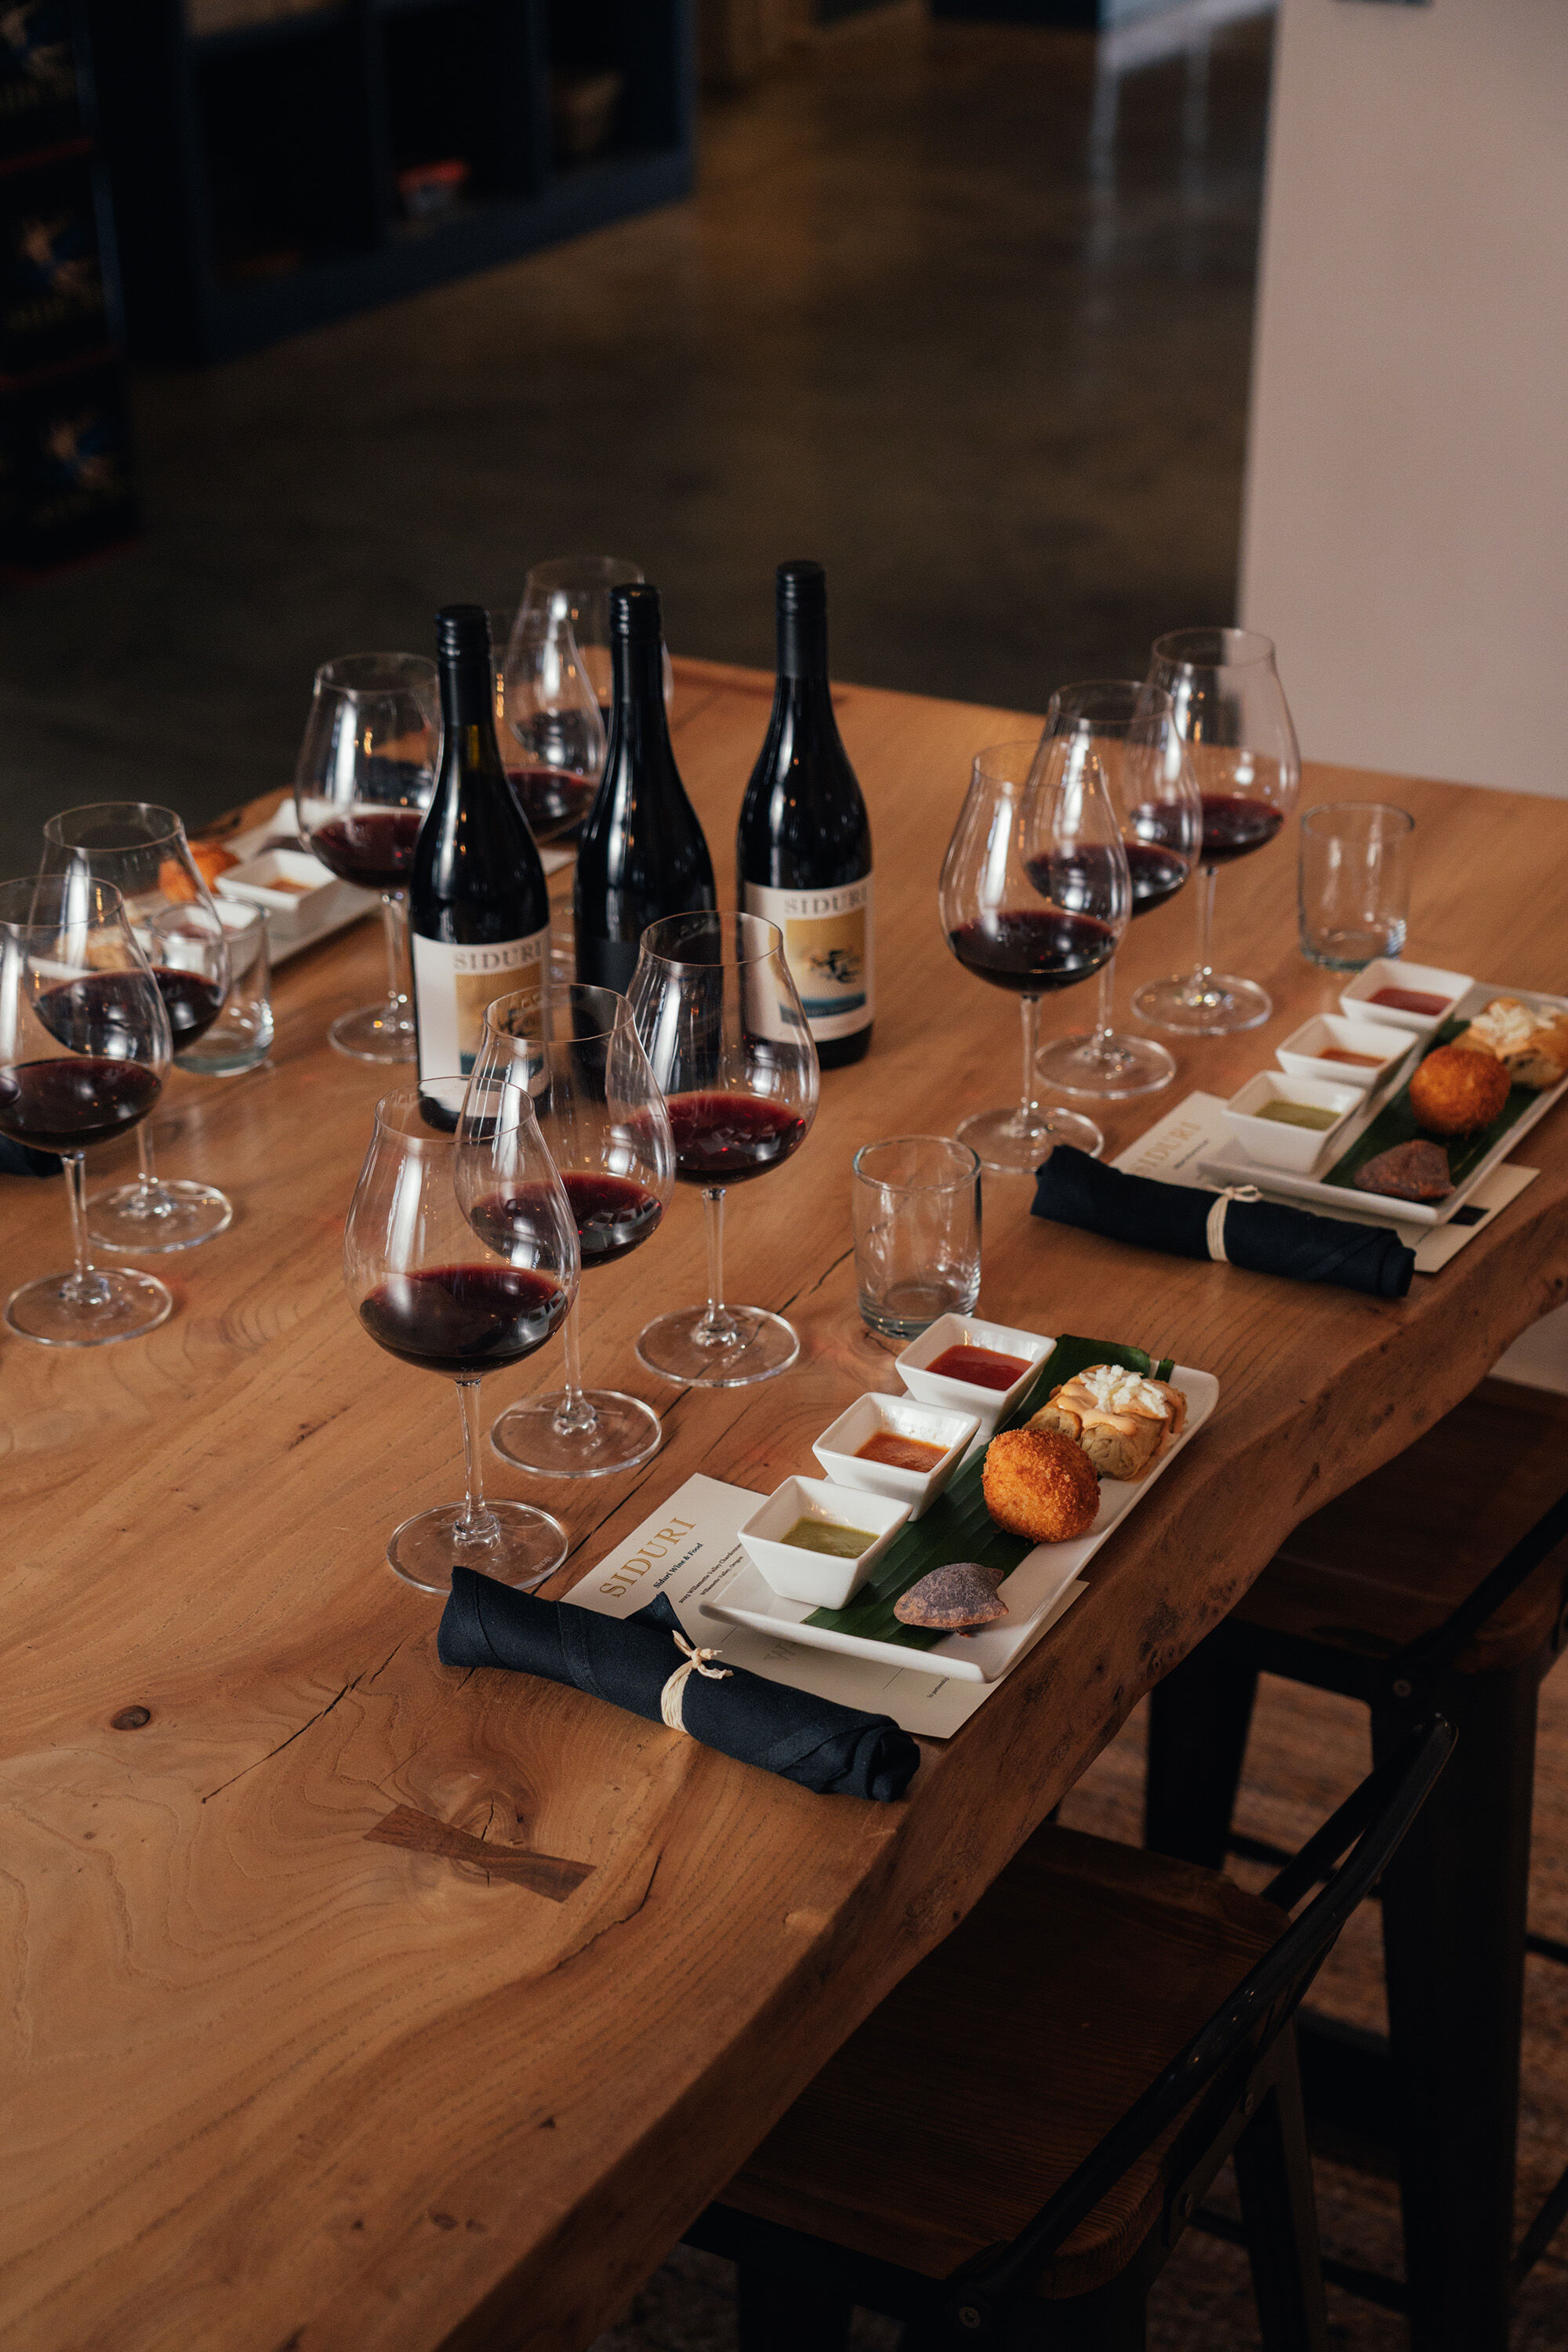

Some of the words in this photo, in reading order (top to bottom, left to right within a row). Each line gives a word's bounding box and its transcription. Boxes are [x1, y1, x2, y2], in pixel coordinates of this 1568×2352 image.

[786, 886, 867, 916] SIDURI
[453, 941, 543, 971] SIDURI
[599, 1516, 697, 1598] SIDURI
[653, 1571, 673, 1589] Siduri
[669, 1559, 686, 1573] Wine
[688, 1542, 703, 1556] Food
[707, 1563, 722, 1575] Valley
